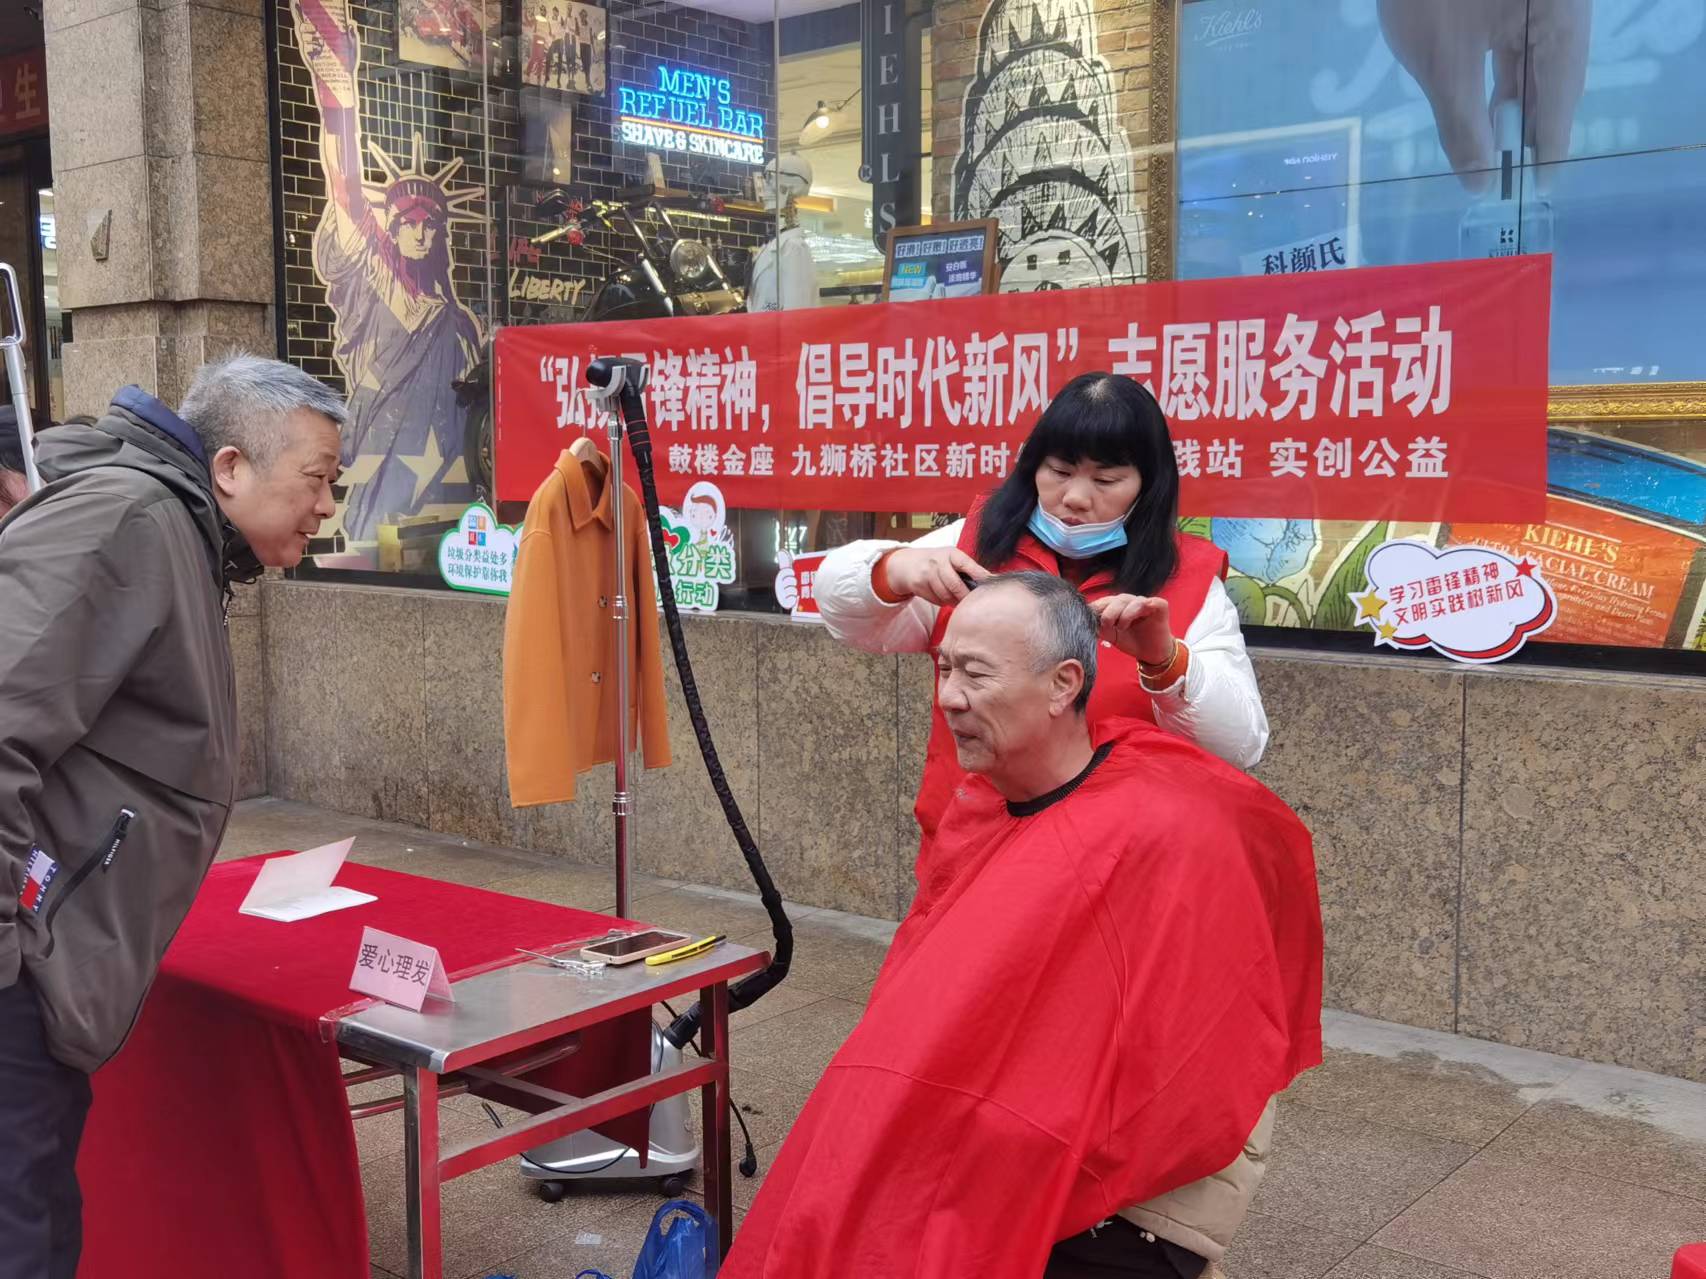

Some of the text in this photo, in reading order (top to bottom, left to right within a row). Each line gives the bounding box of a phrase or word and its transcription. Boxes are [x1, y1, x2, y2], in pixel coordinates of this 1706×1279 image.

[1198, 8, 1263, 40] Kiehl's
[657, 64, 731, 105] MEN'S
[619, 87, 764, 139] REFUEL BAR
[621, 121, 765, 165] SHAVE & SKINCARE
[1262, 236, 1346, 275] 科颜氏
[509, 267, 586, 305] LIBERTY
[668, 436, 1449, 479] 鼓楼金座 九狮桥社区新时践站 实创公益
[1523, 523, 1620, 565] KIEHL'S
[1389, 561, 1500, 605] 学习雷锋精神
[1525, 550, 1590, 581] FACIAL
[1594, 569, 1656, 600] CREAM
[1393, 578, 1524, 626] 文明实践树新风
[32, 864, 58, 913] TOMMY
[359, 943, 430, 986] 爱心理发
